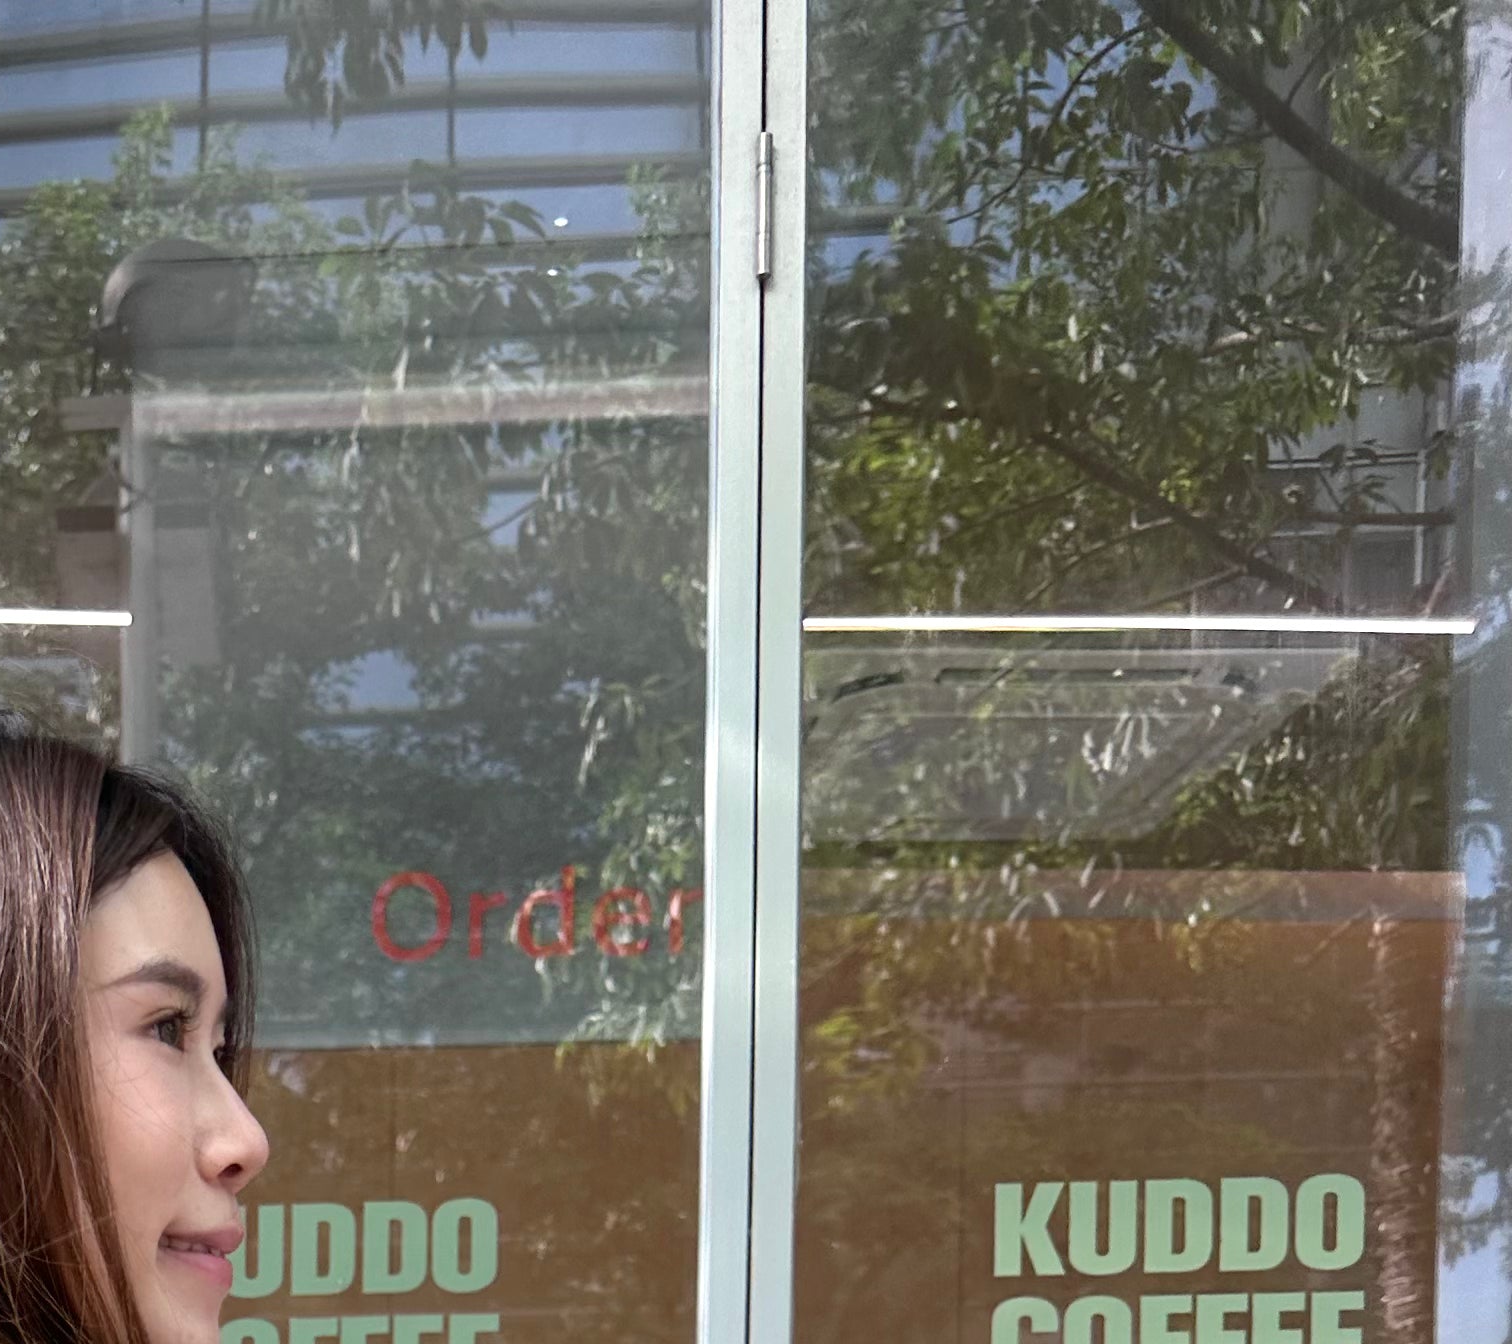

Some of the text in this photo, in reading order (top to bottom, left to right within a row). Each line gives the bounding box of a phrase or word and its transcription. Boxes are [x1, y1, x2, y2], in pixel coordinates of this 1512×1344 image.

[371, 865, 704, 962] Order
[229, 1198, 499, 1299] UDDO
[993, 1174, 1365, 1278] KUDDO
